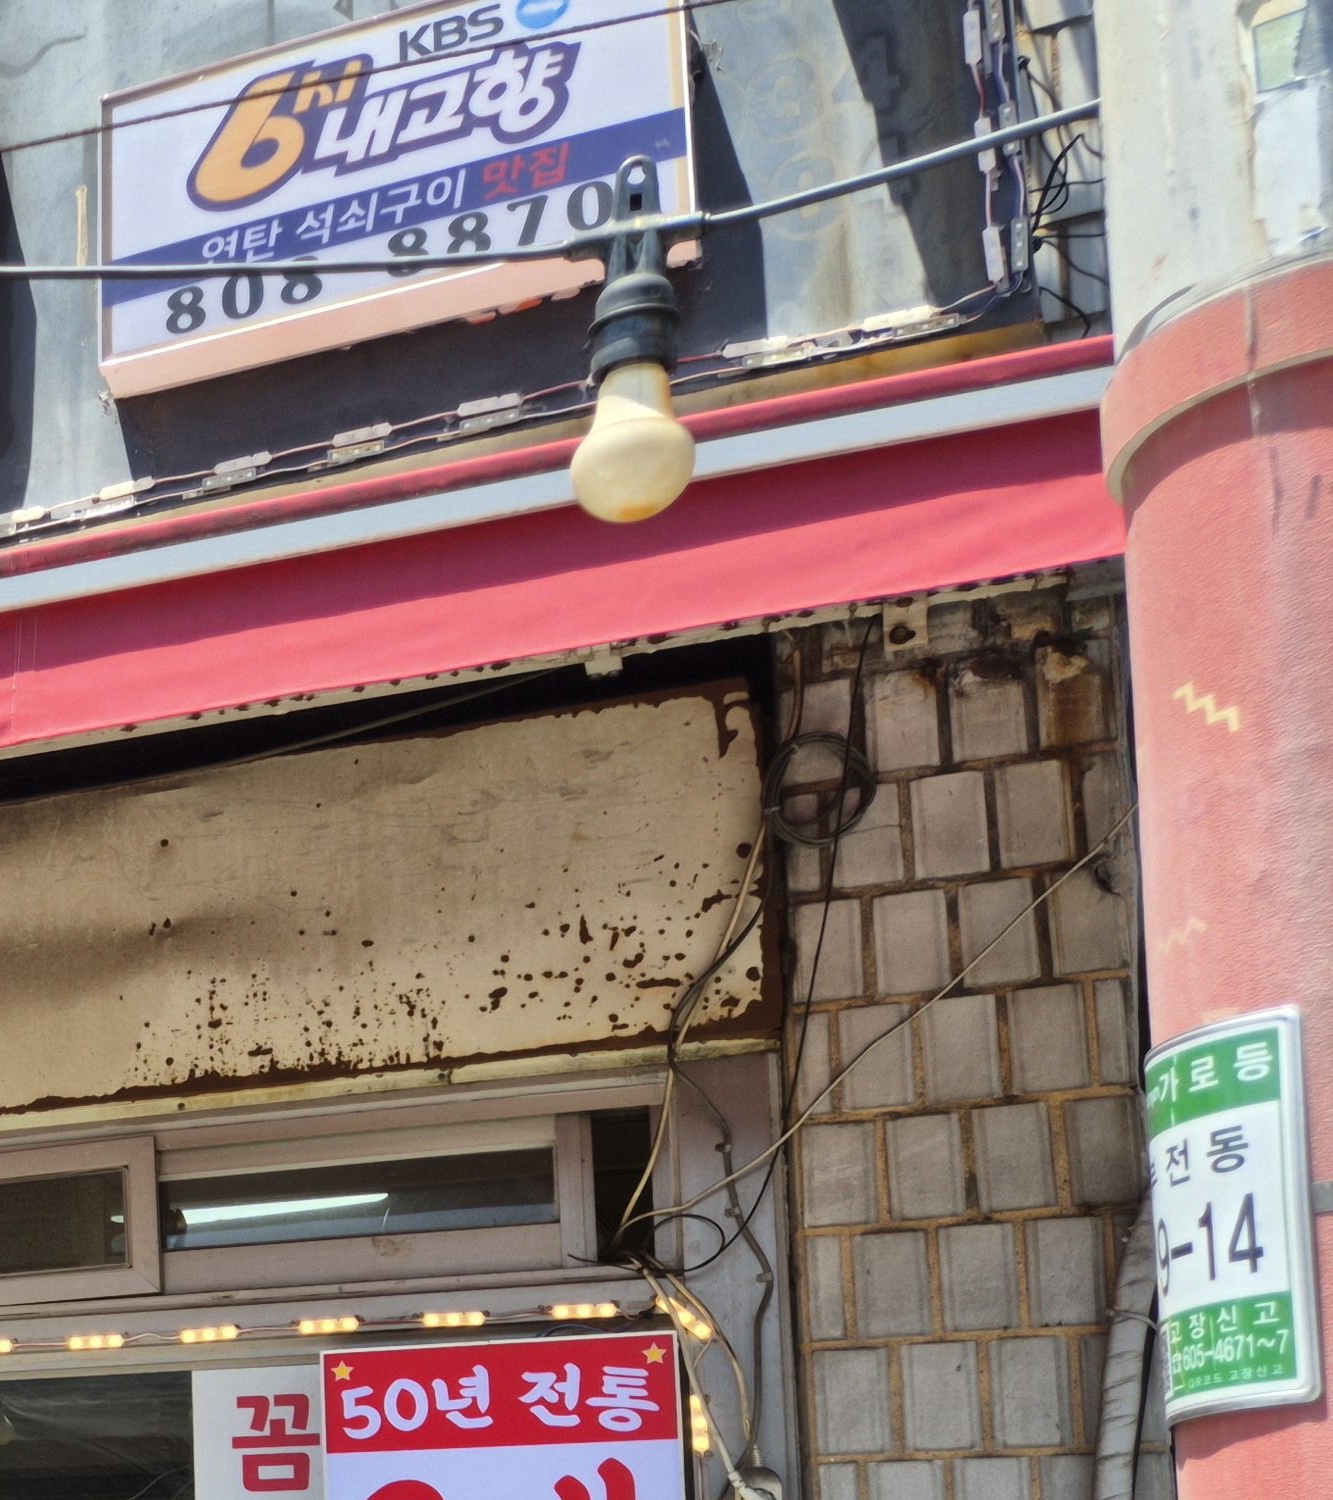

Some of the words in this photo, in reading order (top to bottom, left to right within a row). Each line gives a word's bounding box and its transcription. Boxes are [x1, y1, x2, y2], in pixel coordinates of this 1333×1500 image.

[399, 4, 504, 62] KBS
[189, 55, 370, 208] 6시
[311, 42, 579, 174] 내고향
[201, 221, 283, 265] 연탄
[297, 169, 467, 245] 석쇠구이
[482, 141, 569, 200] 맛집
[166, 256, 323, 334] 808
[387, 182, 615, 278] 8870
[1159, 1040, 1274, 1103] 가로등
[1169, 1301, 1280, 1343] 고장신고
[341, 1362, 494, 1440] 50년
[519, 1362, 661, 1431] 전통
[1228, 1364, 1284, 1383] 고장신고
